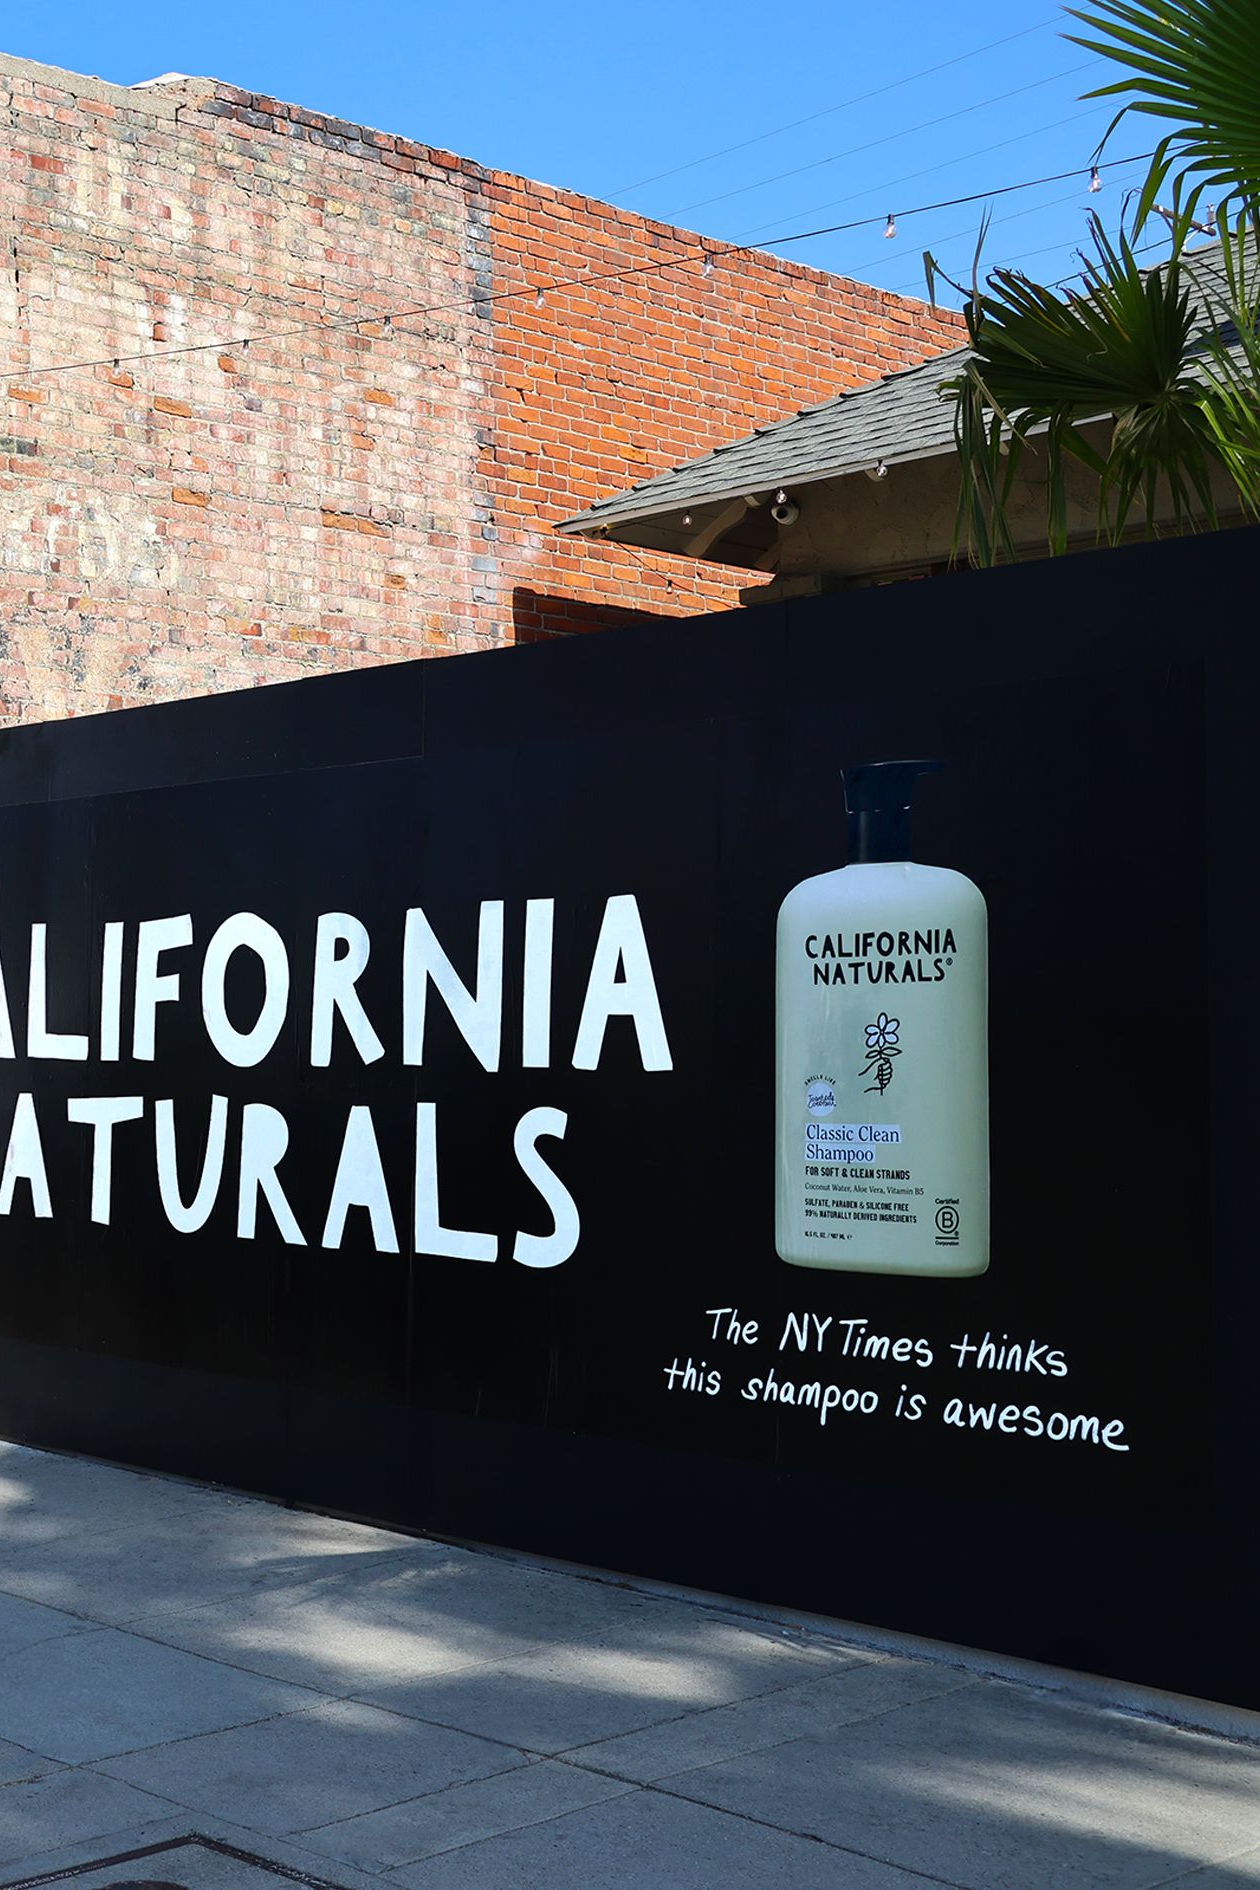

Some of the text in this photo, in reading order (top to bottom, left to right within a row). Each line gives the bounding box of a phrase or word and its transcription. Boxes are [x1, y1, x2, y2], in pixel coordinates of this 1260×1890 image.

[805, 928, 957, 959] CALIFORNIA
[806, 1124, 900, 1143] Classic Clean
[806, 1144, 874, 1164] Shampoo
[805, 1166, 910, 1180] FOR SOFT & CLEAN STRANDS
[804, 1182, 831, 1191] Coconut
[853, 1185, 868, 1193] Aloe
[886, 1186, 913, 1195] Vitamin
[831, 1199, 858, 1209] PARABEN
[866, 1201, 892, 1211] SILICONE
[893, 1203, 909, 1212] FREE
[819, 1210, 852, 1220] NATURALLY
[853, 1212, 878, 1222] DERIVED
[879, 1213, 918, 1224] INGREDIENTS
[706, 1307, 1068, 1376] The NY Times thinks
[664, 1357, 1129, 1450] this shampoo is awesome
